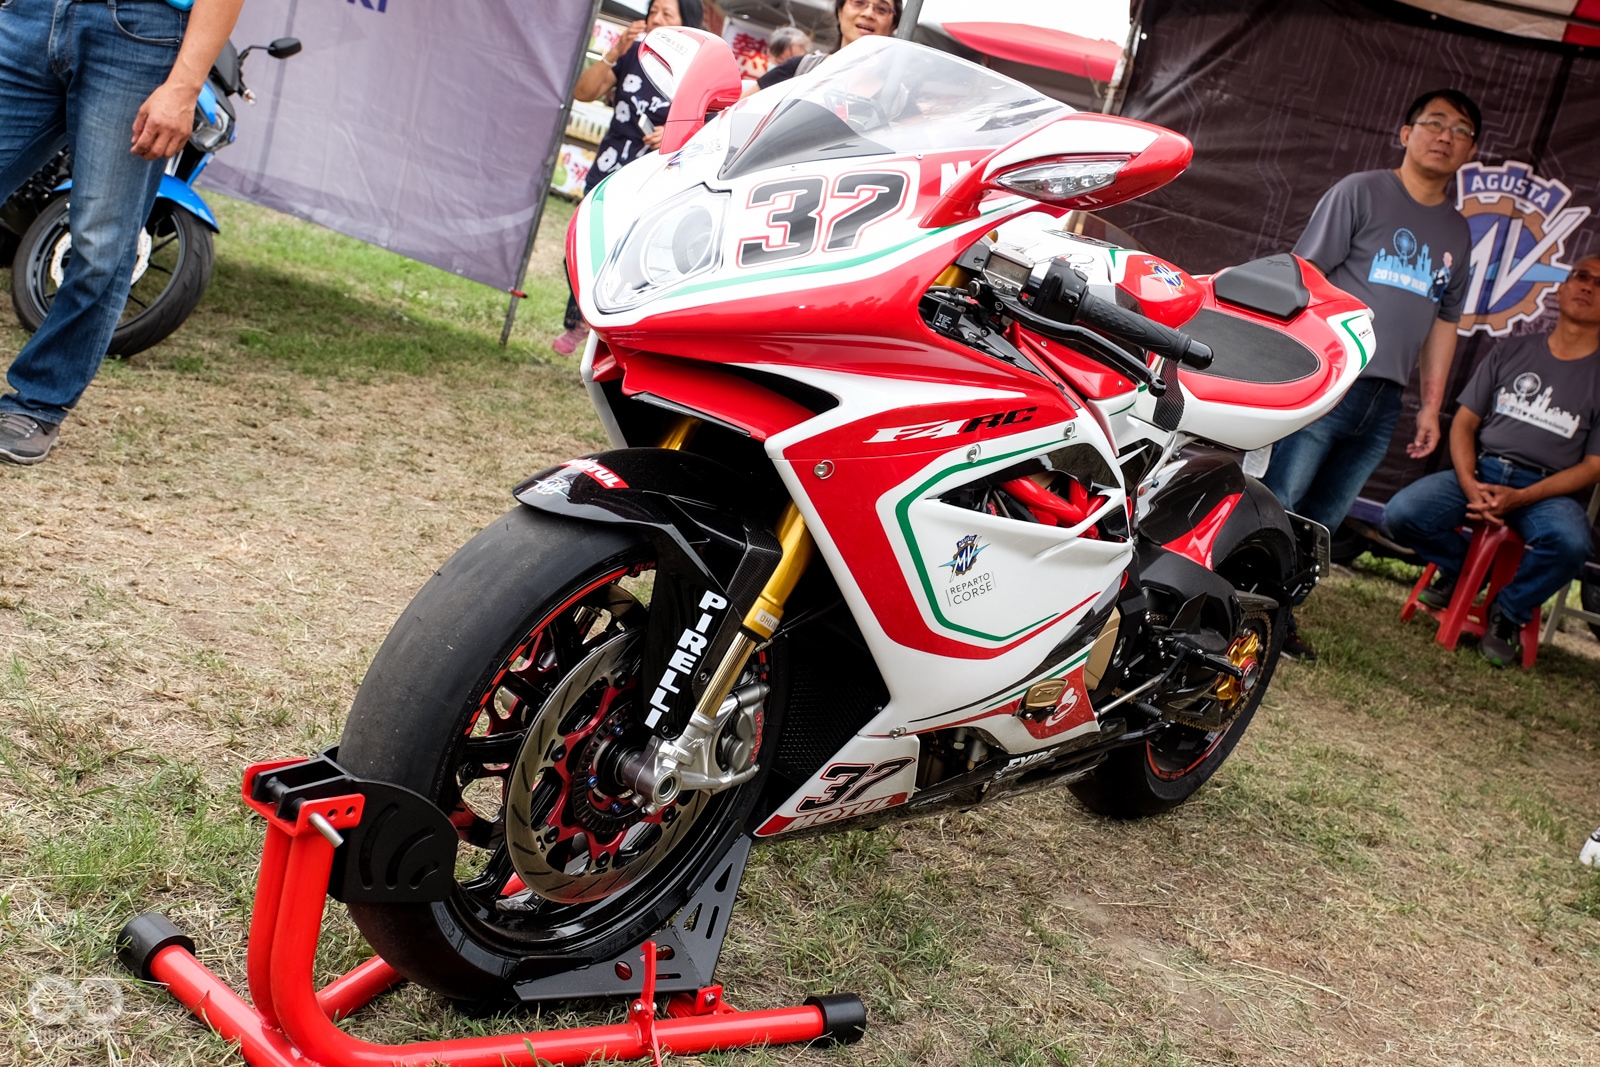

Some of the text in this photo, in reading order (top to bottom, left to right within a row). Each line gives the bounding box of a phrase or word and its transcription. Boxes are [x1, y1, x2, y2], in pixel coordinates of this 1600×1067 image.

[1471, 174, 1551, 209] AGUSTA
[737, 169, 909, 268] 37
[1372, 267, 1399, 284] 2019
[950, 573, 990, 595] REPARTO
[953, 581, 993, 605] CORSE
[644, 590, 728, 729] PIRELLI
[796, 757, 916, 813] 37
[781, 795, 894, 833] MOTUL
